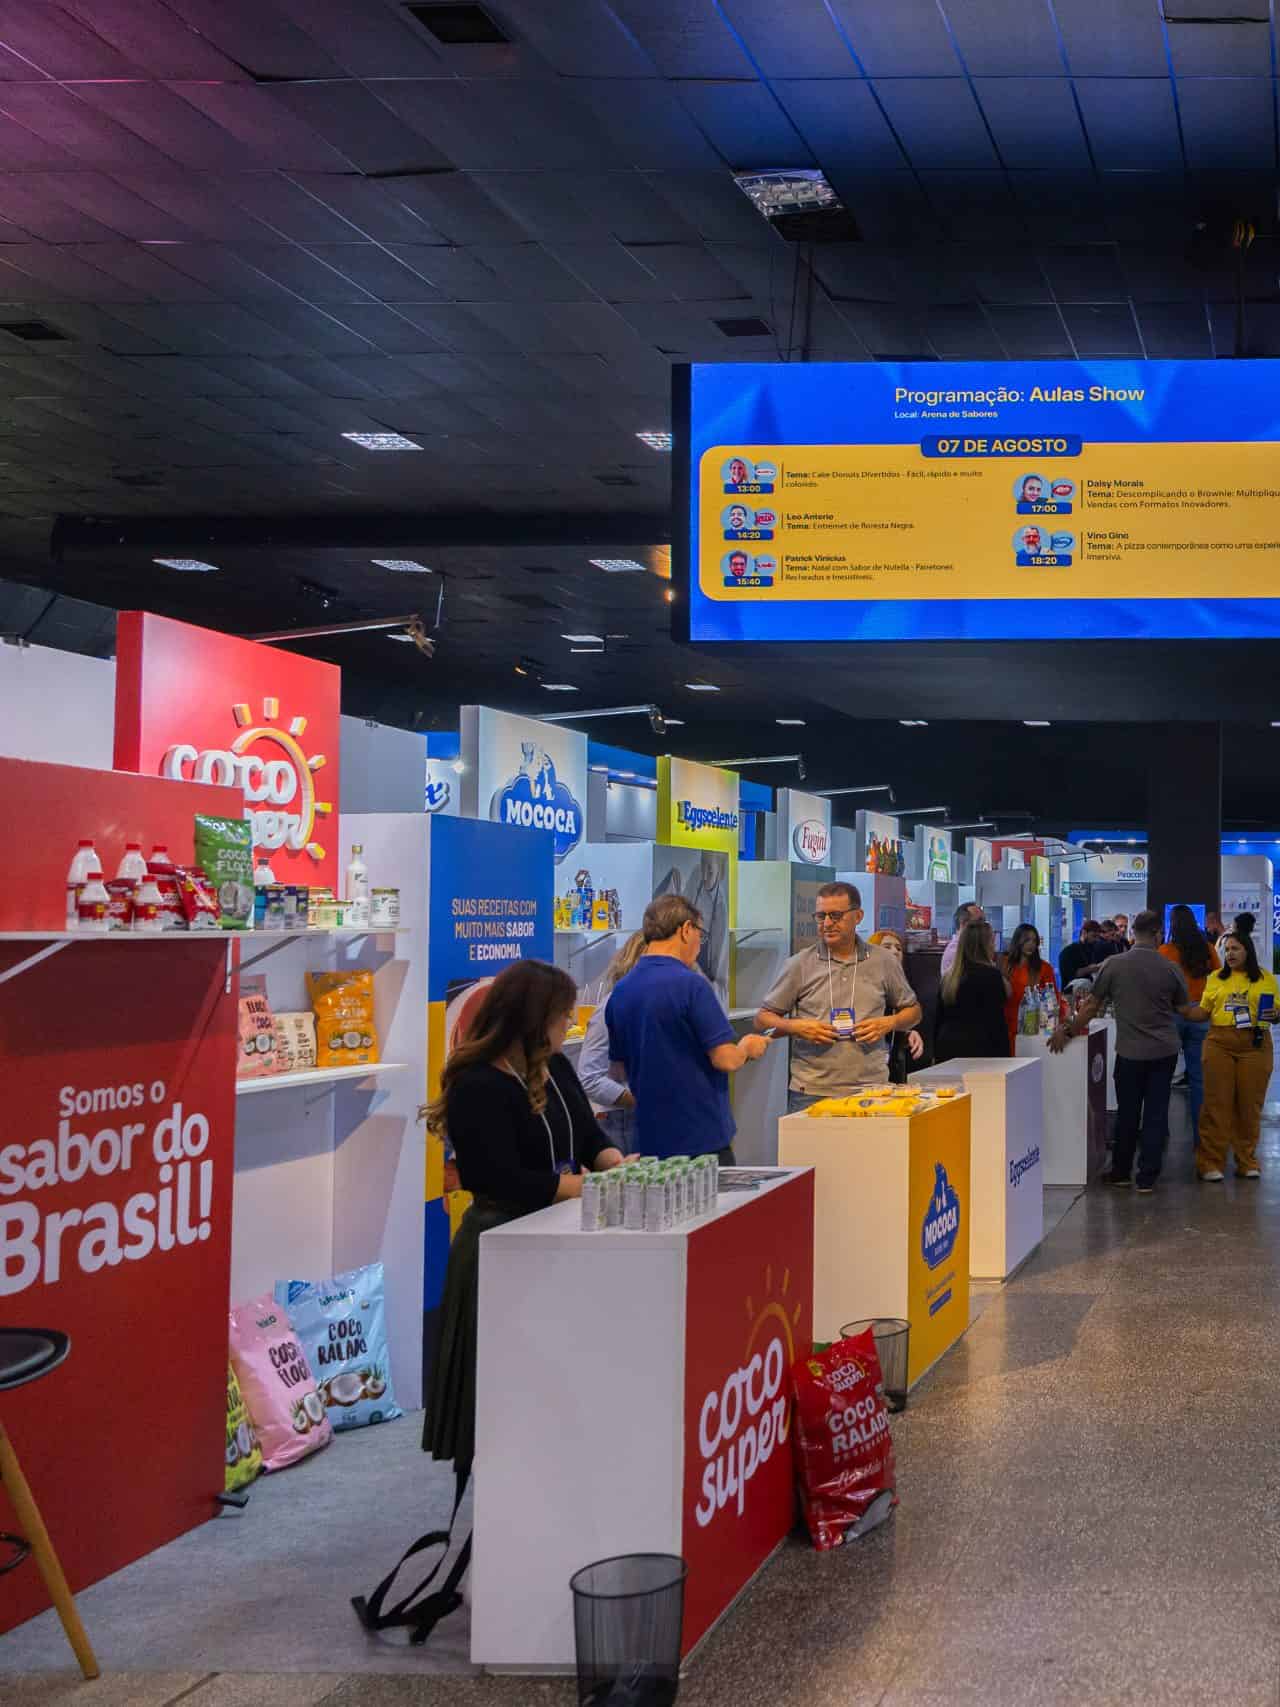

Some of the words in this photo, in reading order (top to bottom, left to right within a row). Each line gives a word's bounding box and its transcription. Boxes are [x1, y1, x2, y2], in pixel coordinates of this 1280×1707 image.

[895, 387, 1024, 406] Programação:
[1030, 386, 1085, 402] Aulas
[1089, 386, 1145, 402] Show
[949, 410, 960, 418] de
[962, 410, 999, 418] Sabores
[937, 439, 960, 453] 07
[963, 439, 987, 453] DE
[991, 438, 1067, 453] AGOSTO
[1087, 480, 1112, 490] Daisy
[1114, 479, 1144, 488] Morais
[1087, 490, 1114, 498] Tema:
[1116, 489, 1187, 499] Descomplicando
[1032, 505, 1057, 513] 17:00
[1140, 500, 1179, 508] Formatos
[1087, 532, 1107, 540] Vino
[1087, 542, 1114, 550] Tema:
[167, 745, 297, 804] coco
[506, 799, 576, 834] MOCOCA
[683, 800, 737, 830] Eggscelente
[802, 826, 828, 858] Fugini
[452, 898, 477, 916] SUAS
[478, 899, 519, 916] RECEITAS
[520, 899, 537, 915] COM
[455, 921, 482, 939] MUITO
[506, 921, 535, 937] SABOR
[469, 944, 476, 960] E
[477, 944, 521, 960] ECONOMIA
[59, 1083, 145, 1117] Somos
[151, 1080, 165, 1103] o
[0, 1119, 145, 1195] sabor
[153, 1102, 209, 1163] do
[0, 1160, 213, 1296] Brasil!
[924, 1206, 957, 1249] MOCOCA
[328, 1318, 363, 1341] COCO
[699, 1337, 783, 1458] coco
[829, 1395, 875, 1433] COCO
[696, 1396, 786, 1527] super
